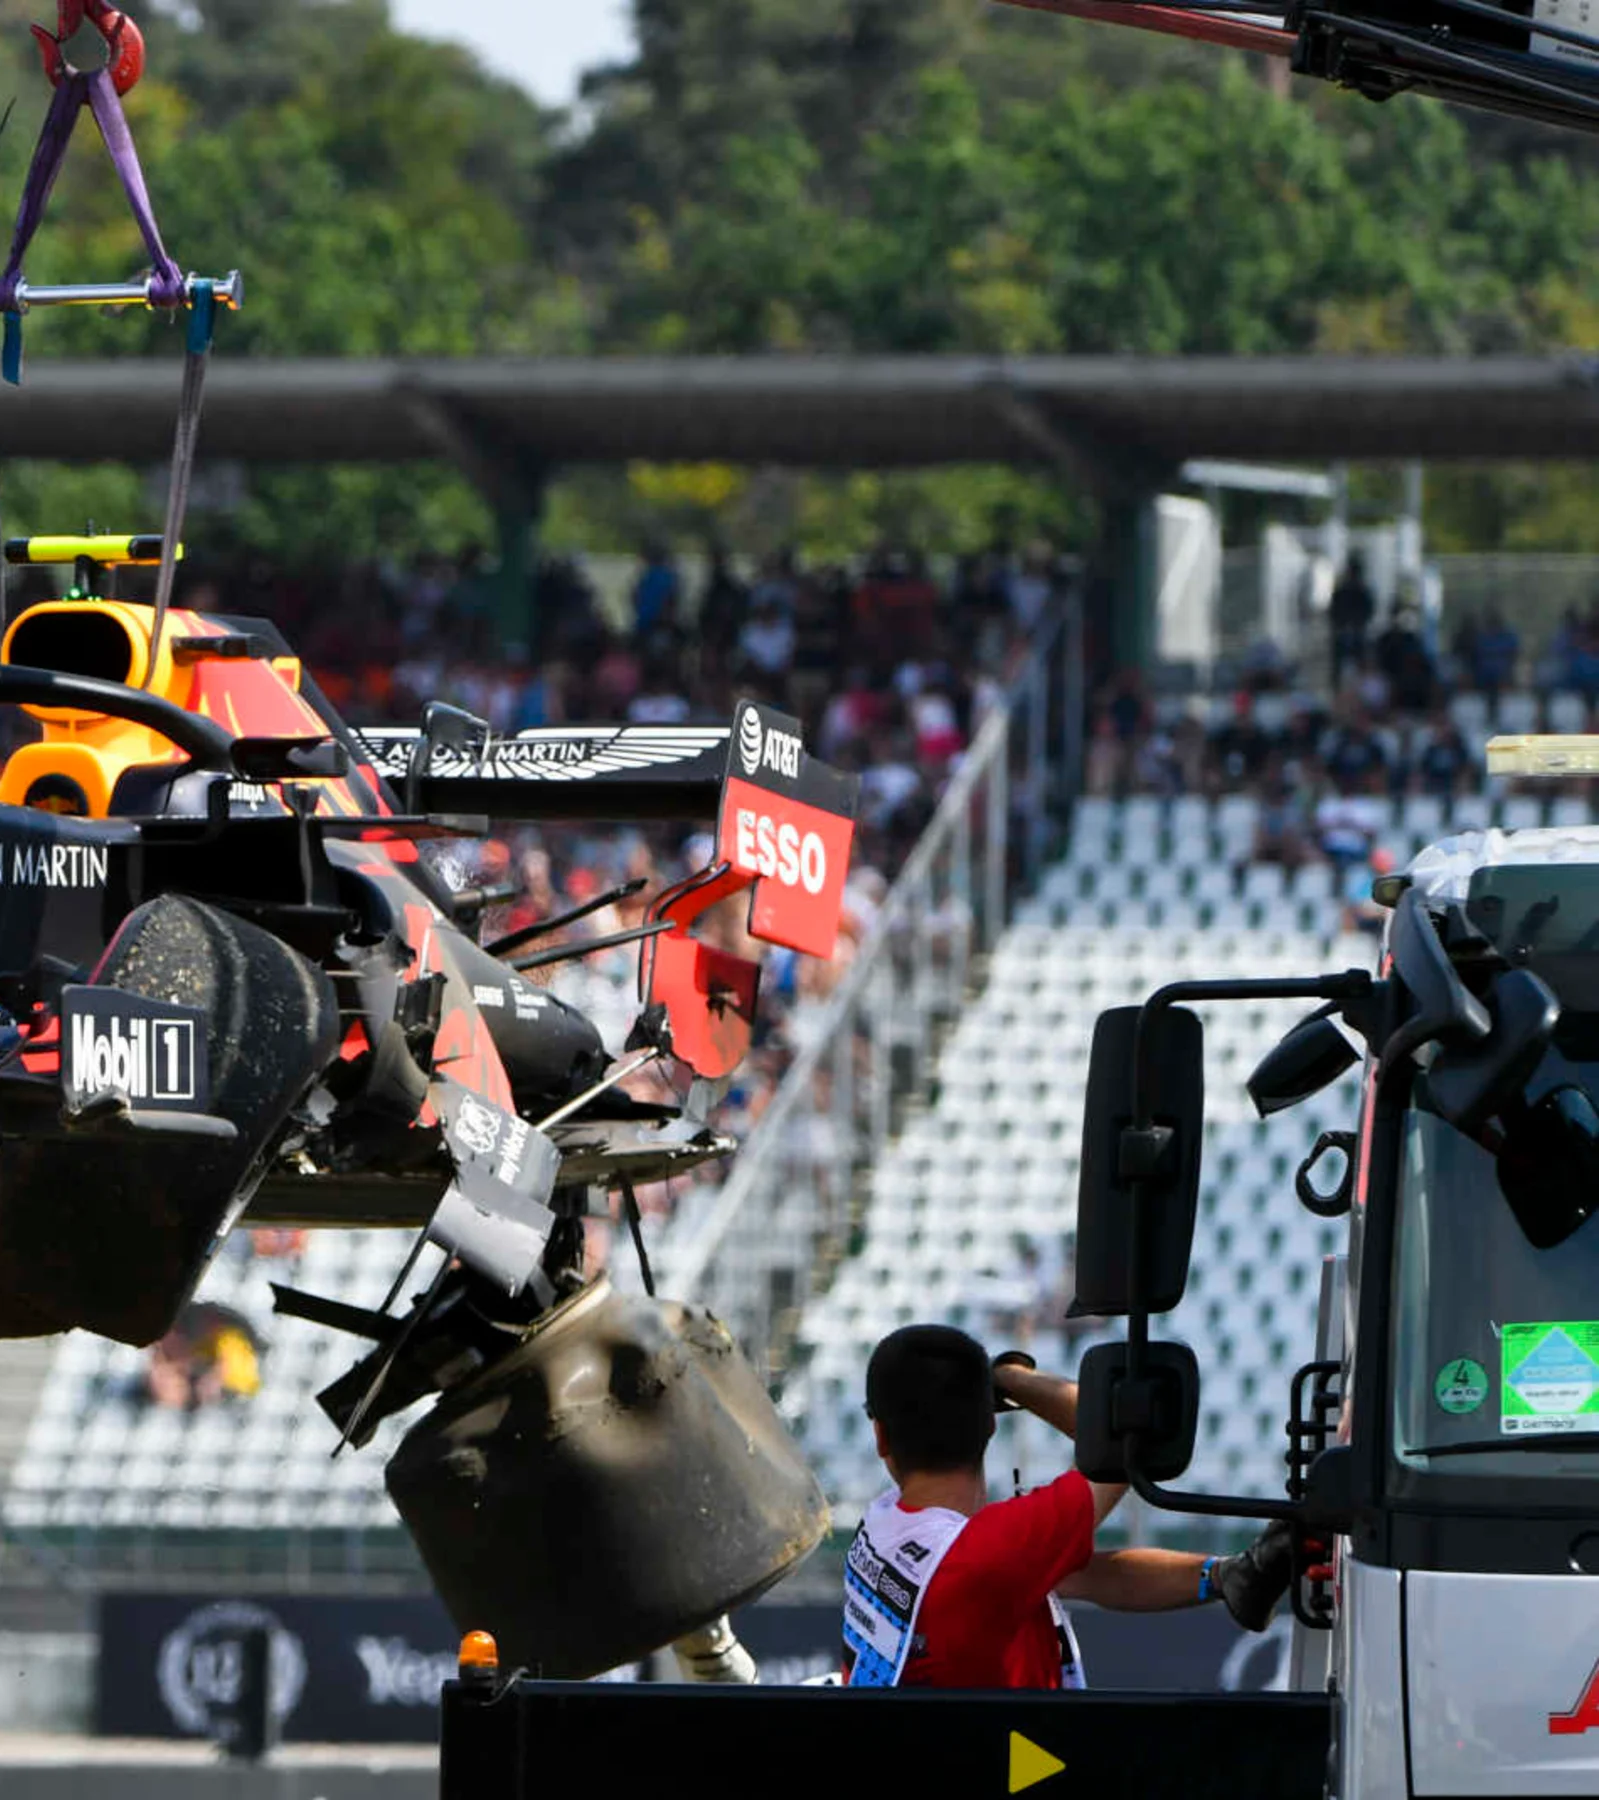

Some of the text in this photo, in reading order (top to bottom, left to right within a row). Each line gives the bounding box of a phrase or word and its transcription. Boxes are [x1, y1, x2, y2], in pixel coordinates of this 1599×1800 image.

[496, 743, 586, 762] MARTIN
[762, 727, 802, 778] AT&T
[12, 844, 108, 888] MARTIN
[737, 808, 826, 894] ESSO
[72, 1013, 147, 1098] Mobil
